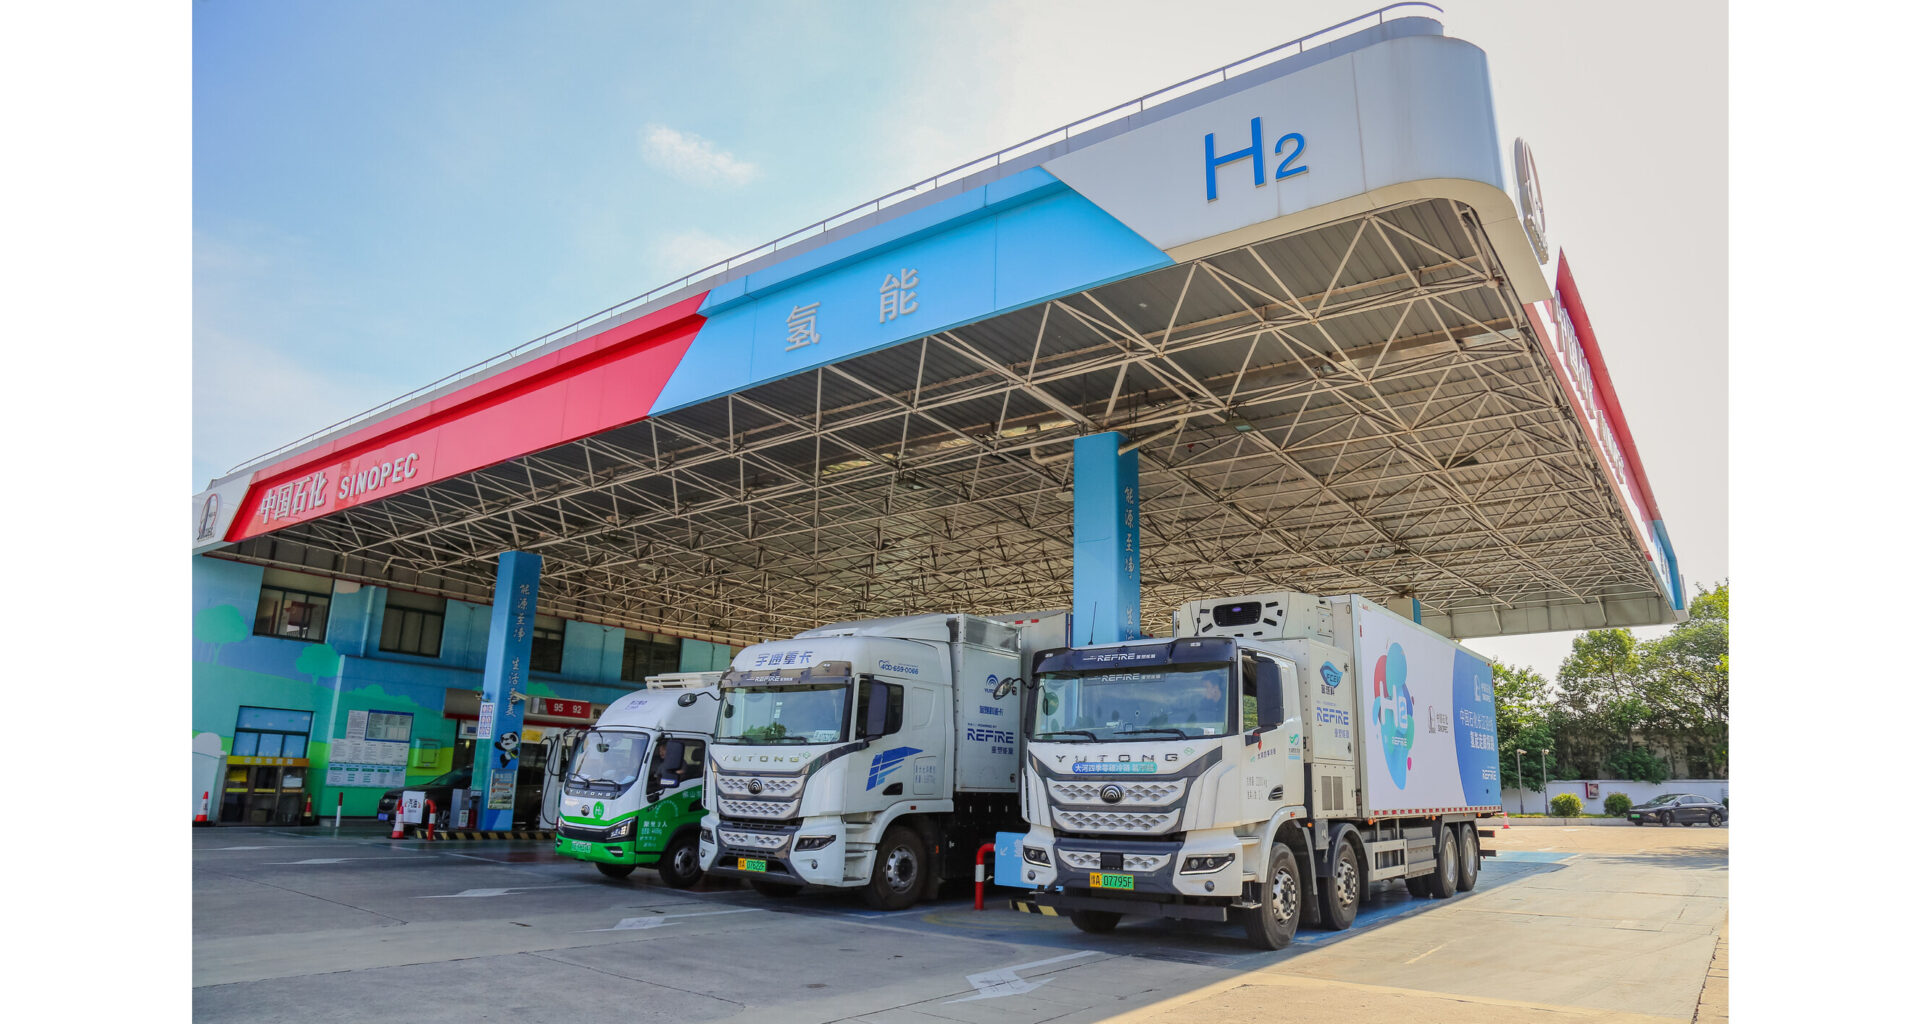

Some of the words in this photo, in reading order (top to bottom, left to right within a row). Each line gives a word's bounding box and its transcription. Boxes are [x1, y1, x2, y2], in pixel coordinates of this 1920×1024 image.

[1205, 116, 1308, 202] H2
[785, 268, 919, 351] 氢能
[260, 471, 328, 524] 中国石化
[338, 453, 419, 500] SINOPEC
[755, 651, 813, 666] 宇通重卡
[1096, 652, 1135, 661] REFIRE
[1102, 673, 1140, 682] REFIRE
[553, 703, 564, 712] 95
[572, 705, 582, 714] 92
[1379, 681, 1408, 728] H2
[1316, 706, 1349, 725] REFIRE
[967, 728, 1014, 744] REFIRE
[722, 754, 800, 763] YUTONG
[1055, 753, 1178, 763] YUTONG
[1103, 875, 1132, 888] 07795F
